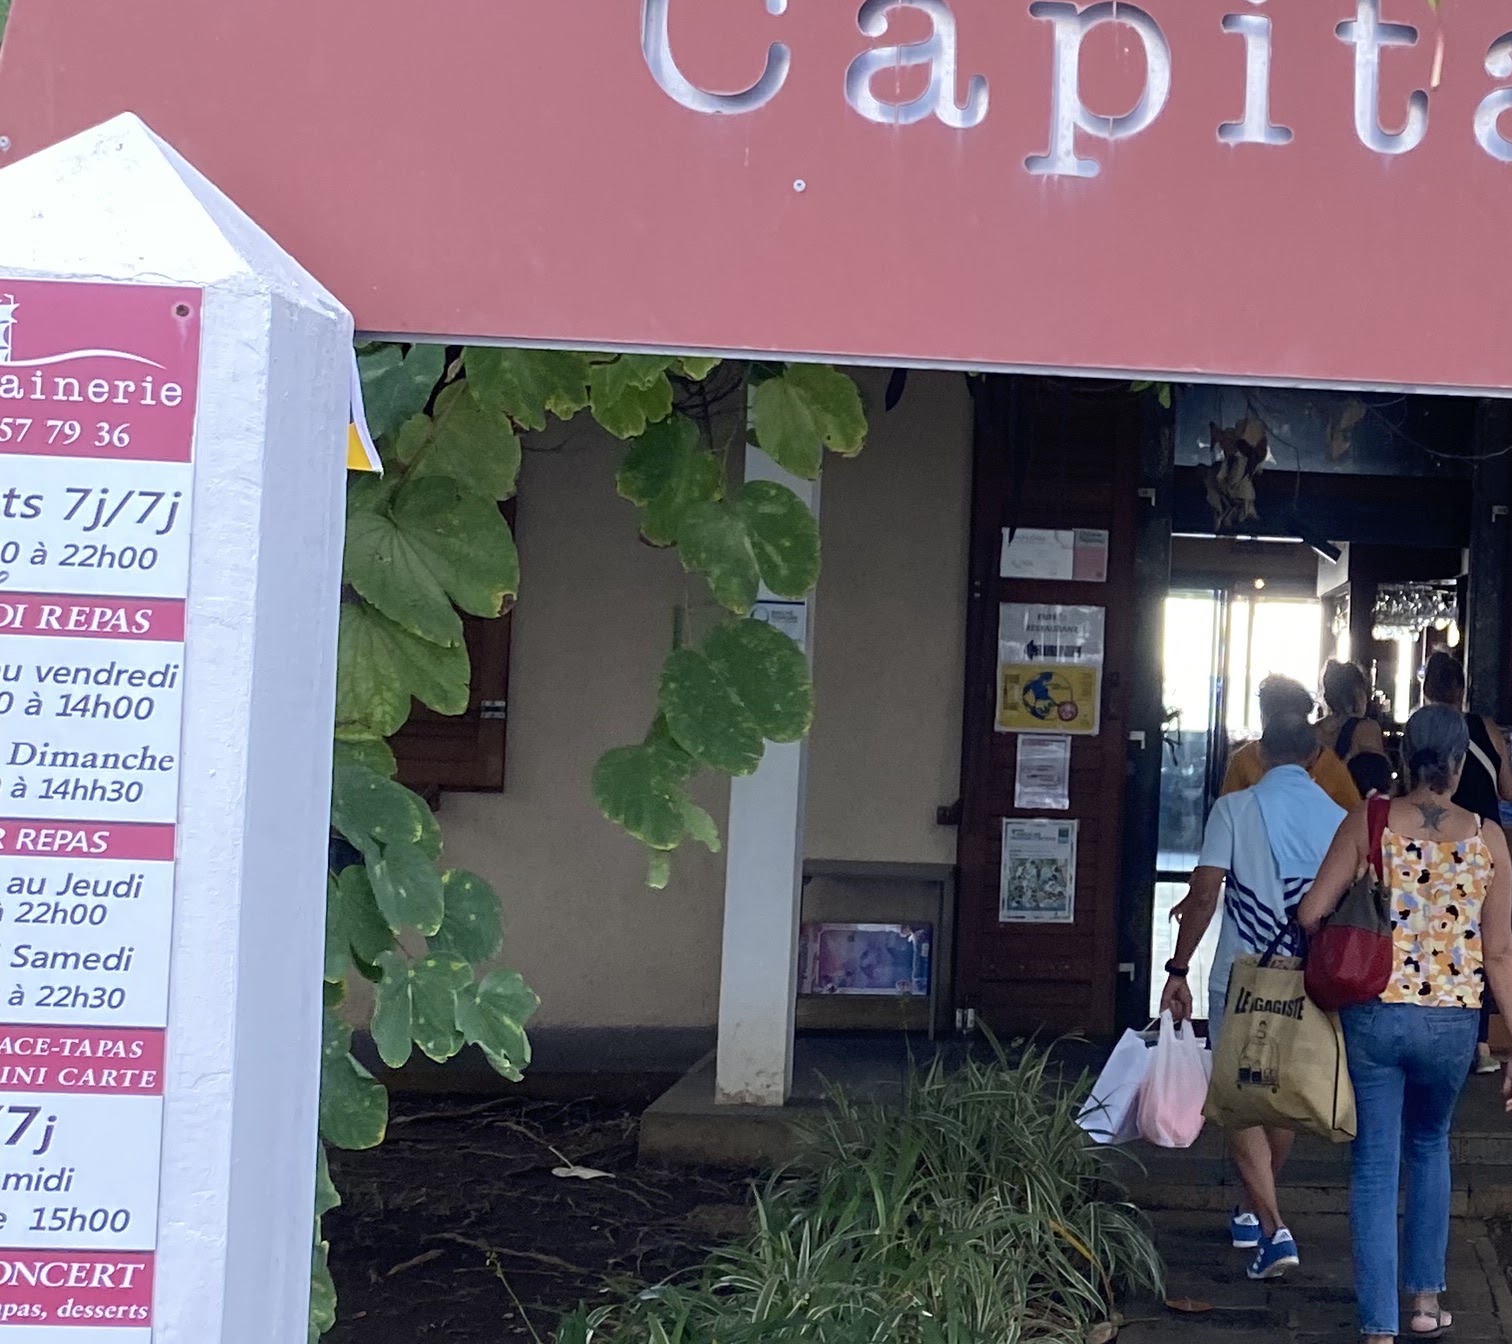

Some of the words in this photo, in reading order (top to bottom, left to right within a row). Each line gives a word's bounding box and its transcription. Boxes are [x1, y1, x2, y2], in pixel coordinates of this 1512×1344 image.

[0, 370, 183, 407] ainerie
[0, 417, 33, 443] 57
[46, 419, 82, 445] 79
[94, 421, 131, 448] 36
[2, 487, 44, 519] ts
[63, 487, 183, 536] 7j/7j
[29, 541, 49, 566] à
[58, 543, 159, 571] 22h00
[36, 604, 153, 635] REPAS
[0, 663, 24, 683] u
[35, 660, 180, 690] vendredi
[24, 690, 44, 717] à
[55, 692, 156, 721] 14h00
[6, 741, 176, 772] Dimanche
[10, 775, 28, 800] à
[38, 777, 145, 804] 14hh30
[16, 828, 111, 854] REPAS
[6, 876, 47, 896] au
[56, 872, 145, 899] Jeudi
[14, 901, 108, 926] 22h00
[10, 944, 135, 972] Samedi
[7, 984, 26, 1007] à
[35, 985, 127, 1009] 22h30
[57, 1067, 157, 1089] CARTE
[0, 1104, 58, 1156] 7j
[1, 1166, 76, 1192] midi
[28, 1207, 131, 1233] 15h00
[0, 1300, 48, 1322] pas,
[57, 1297, 149, 1320] desserts
